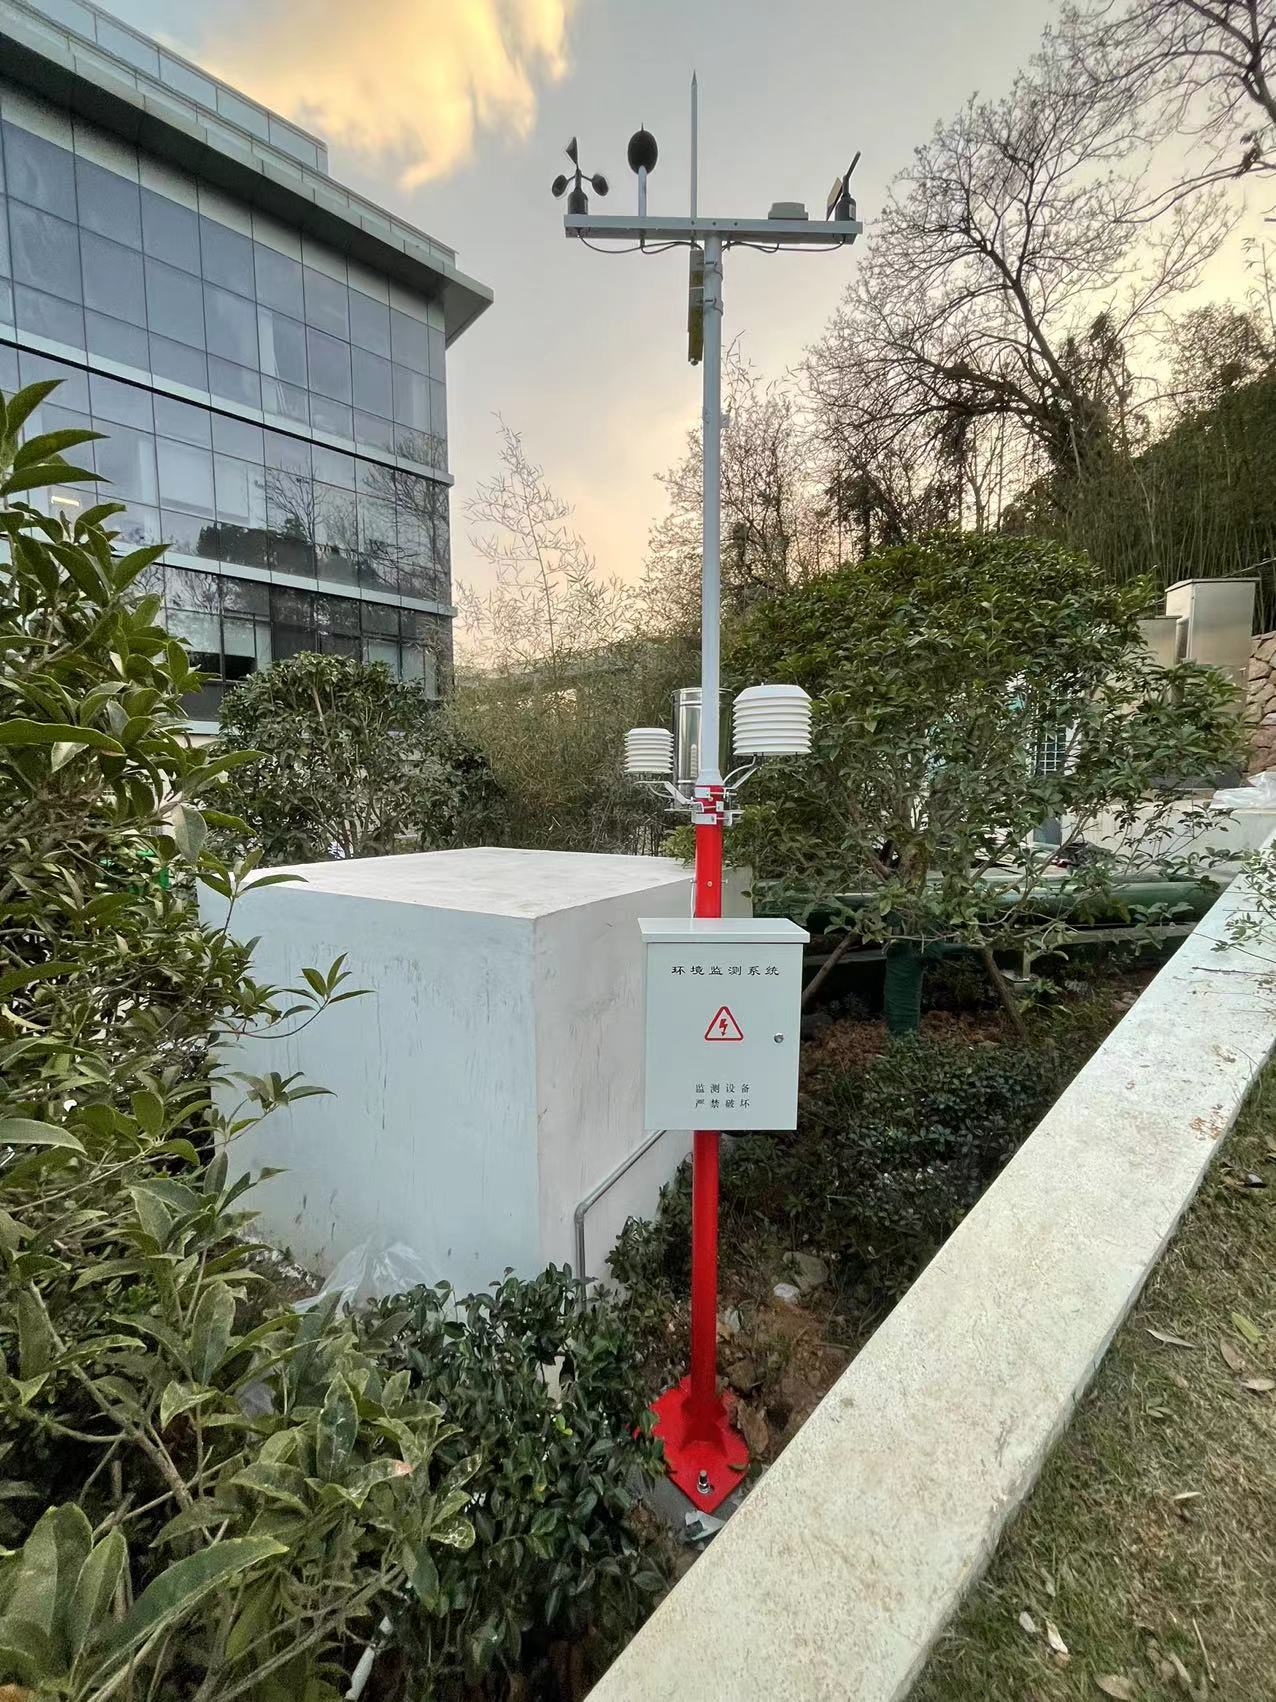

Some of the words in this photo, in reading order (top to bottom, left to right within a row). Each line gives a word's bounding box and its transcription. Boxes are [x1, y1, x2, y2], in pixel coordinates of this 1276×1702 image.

[671, 965, 780, 976] 环境监测系统
[695, 1083, 750, 1094] 监测设备
[694, 1099, 750, 1109] 严禁破坏
